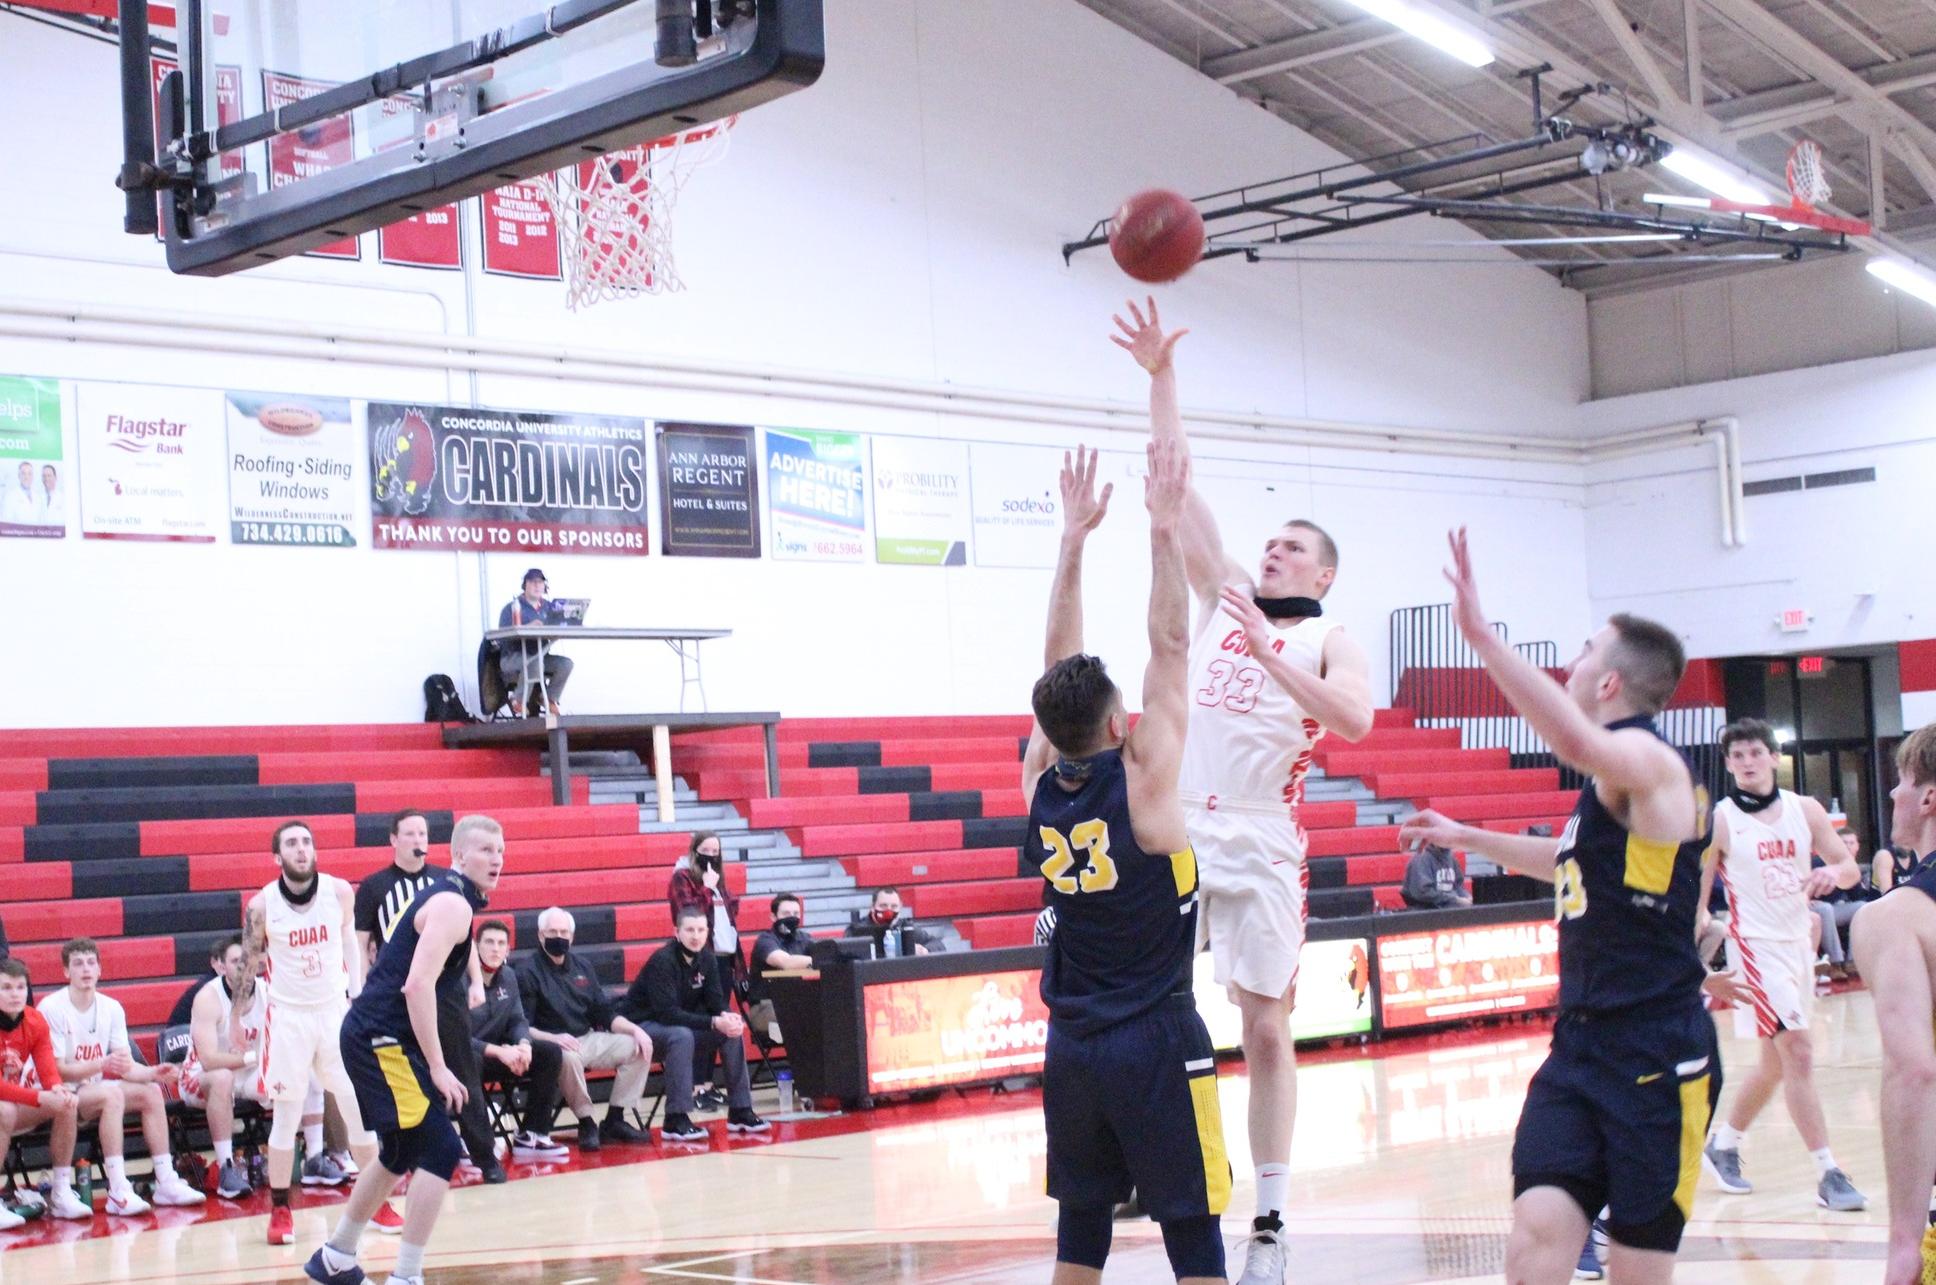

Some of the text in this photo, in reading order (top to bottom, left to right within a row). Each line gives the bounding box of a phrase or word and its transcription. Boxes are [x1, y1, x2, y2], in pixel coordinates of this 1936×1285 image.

[492, 205, 550, 223] TOURNAMENT
[499, 197, 541, 212] NATIONAL
[106, 414, 188, 438] Flagstar
[441, 416, 643, 441] CONCORDIA UNIVERSITY ATHLETICS
[156, 443, 184, 455] Bank
[669, 452, 747, 468] ANN ARBOR
[234, 454, 352, 480] Roofing Siding
[441, 434, 644, 512] CARDINALS
[672, 467, 745, 487] REGENT
[769, 451, 863, 491] ADVERTISE
[260, 480, 329, 500] Windows
[779, 475, 855, 518] HERE!
[673, 497, 748, 512] HOTEL & SUITES
[1002, 496, 1055, 514] sodexo
[241, 523, 343, 543] 734.429.0616
[378, 523, 644, 548] THANK YOU TO OUR SPONSORS
[1785, 611, 1803, 625] EXIT
[1803, 657, 1823, 672] EXIT
[1197, 658, 1265, 714] 33
[1039, 818, 1119, 895] 23
[1758, 839, 1796, 861] CUAA
[289, 924, 328, 947] CUAA
[301, 950, 323, 977] 3
